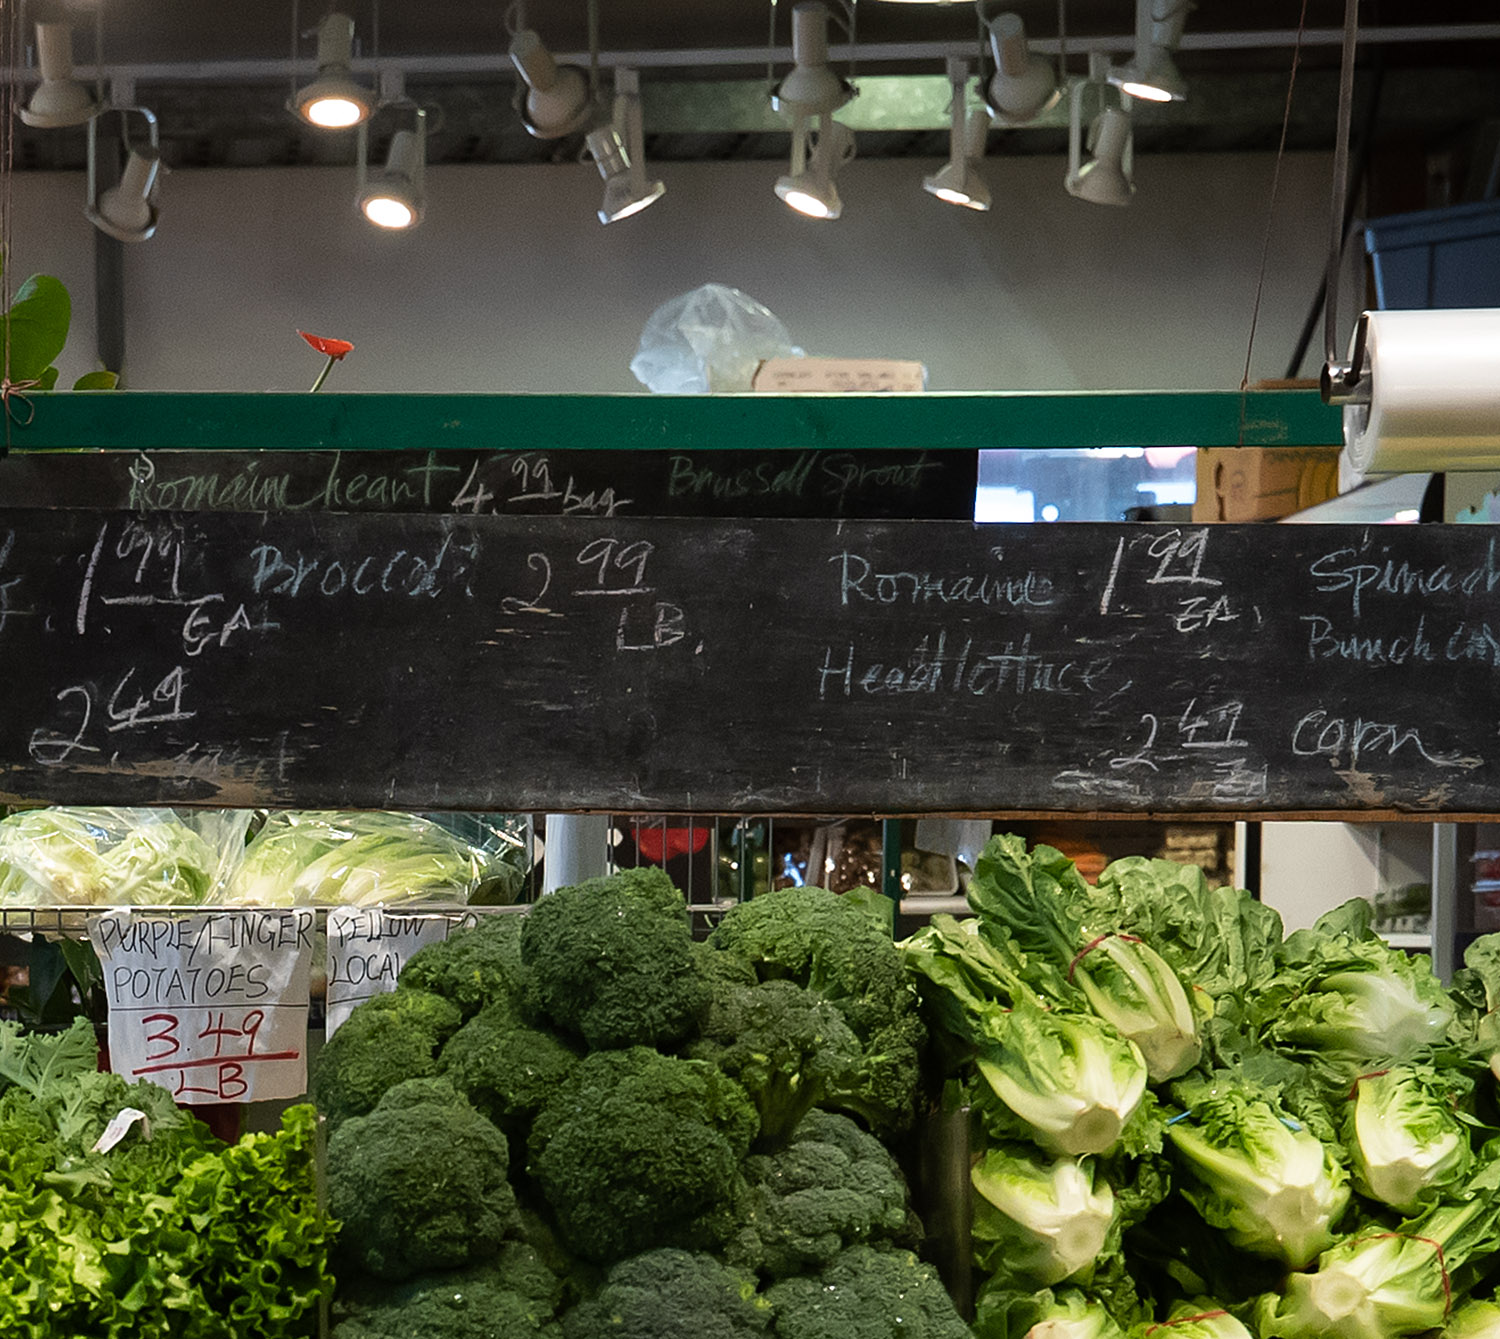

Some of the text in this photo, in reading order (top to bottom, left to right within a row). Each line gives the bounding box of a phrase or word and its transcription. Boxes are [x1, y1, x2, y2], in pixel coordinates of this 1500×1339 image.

[828, 549, 1055, 606] Romaine
[1299, 613, 1435, 664] Bunch
[333, 907, 426, 949] YELLOW
[113, 964, 270, 1004] POTATOES
[173, 1061, 249, 1100] LB
